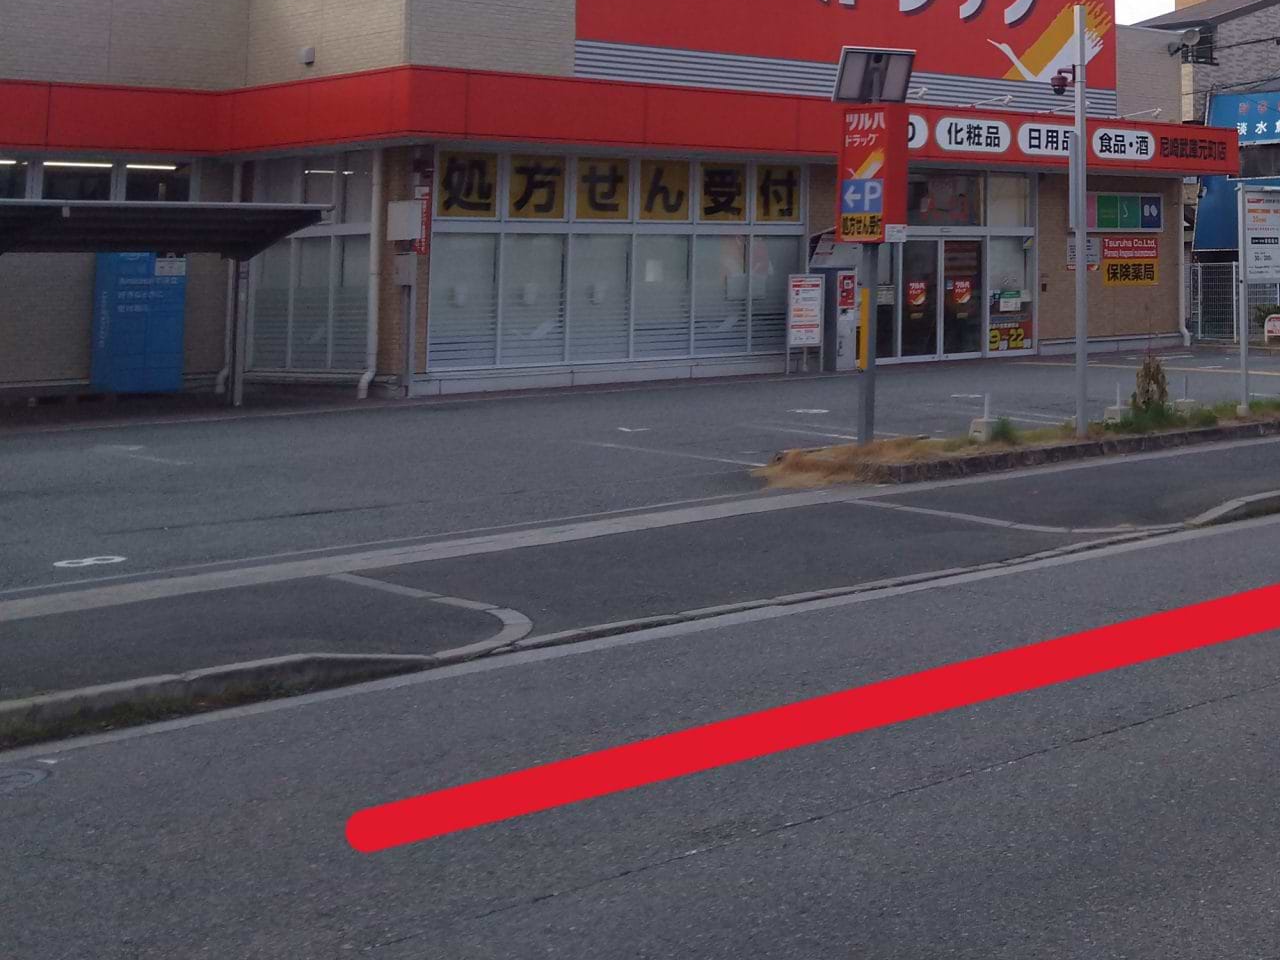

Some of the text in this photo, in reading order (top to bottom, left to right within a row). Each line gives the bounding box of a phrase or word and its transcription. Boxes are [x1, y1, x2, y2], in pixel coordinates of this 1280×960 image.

[846, 112, 886, 131] ツルハ
[845, 133, 878, 147] ドラッグ
[947, 122, 1001, 148] 化粧品
[1099, 132, 1149, 156] 食品・酒
[442, 157, 799, 217] 処方せん受付
[1104, 238, 1132, 247] Tsuruha
[1107, 263, 1154, 281] 保険薬局
